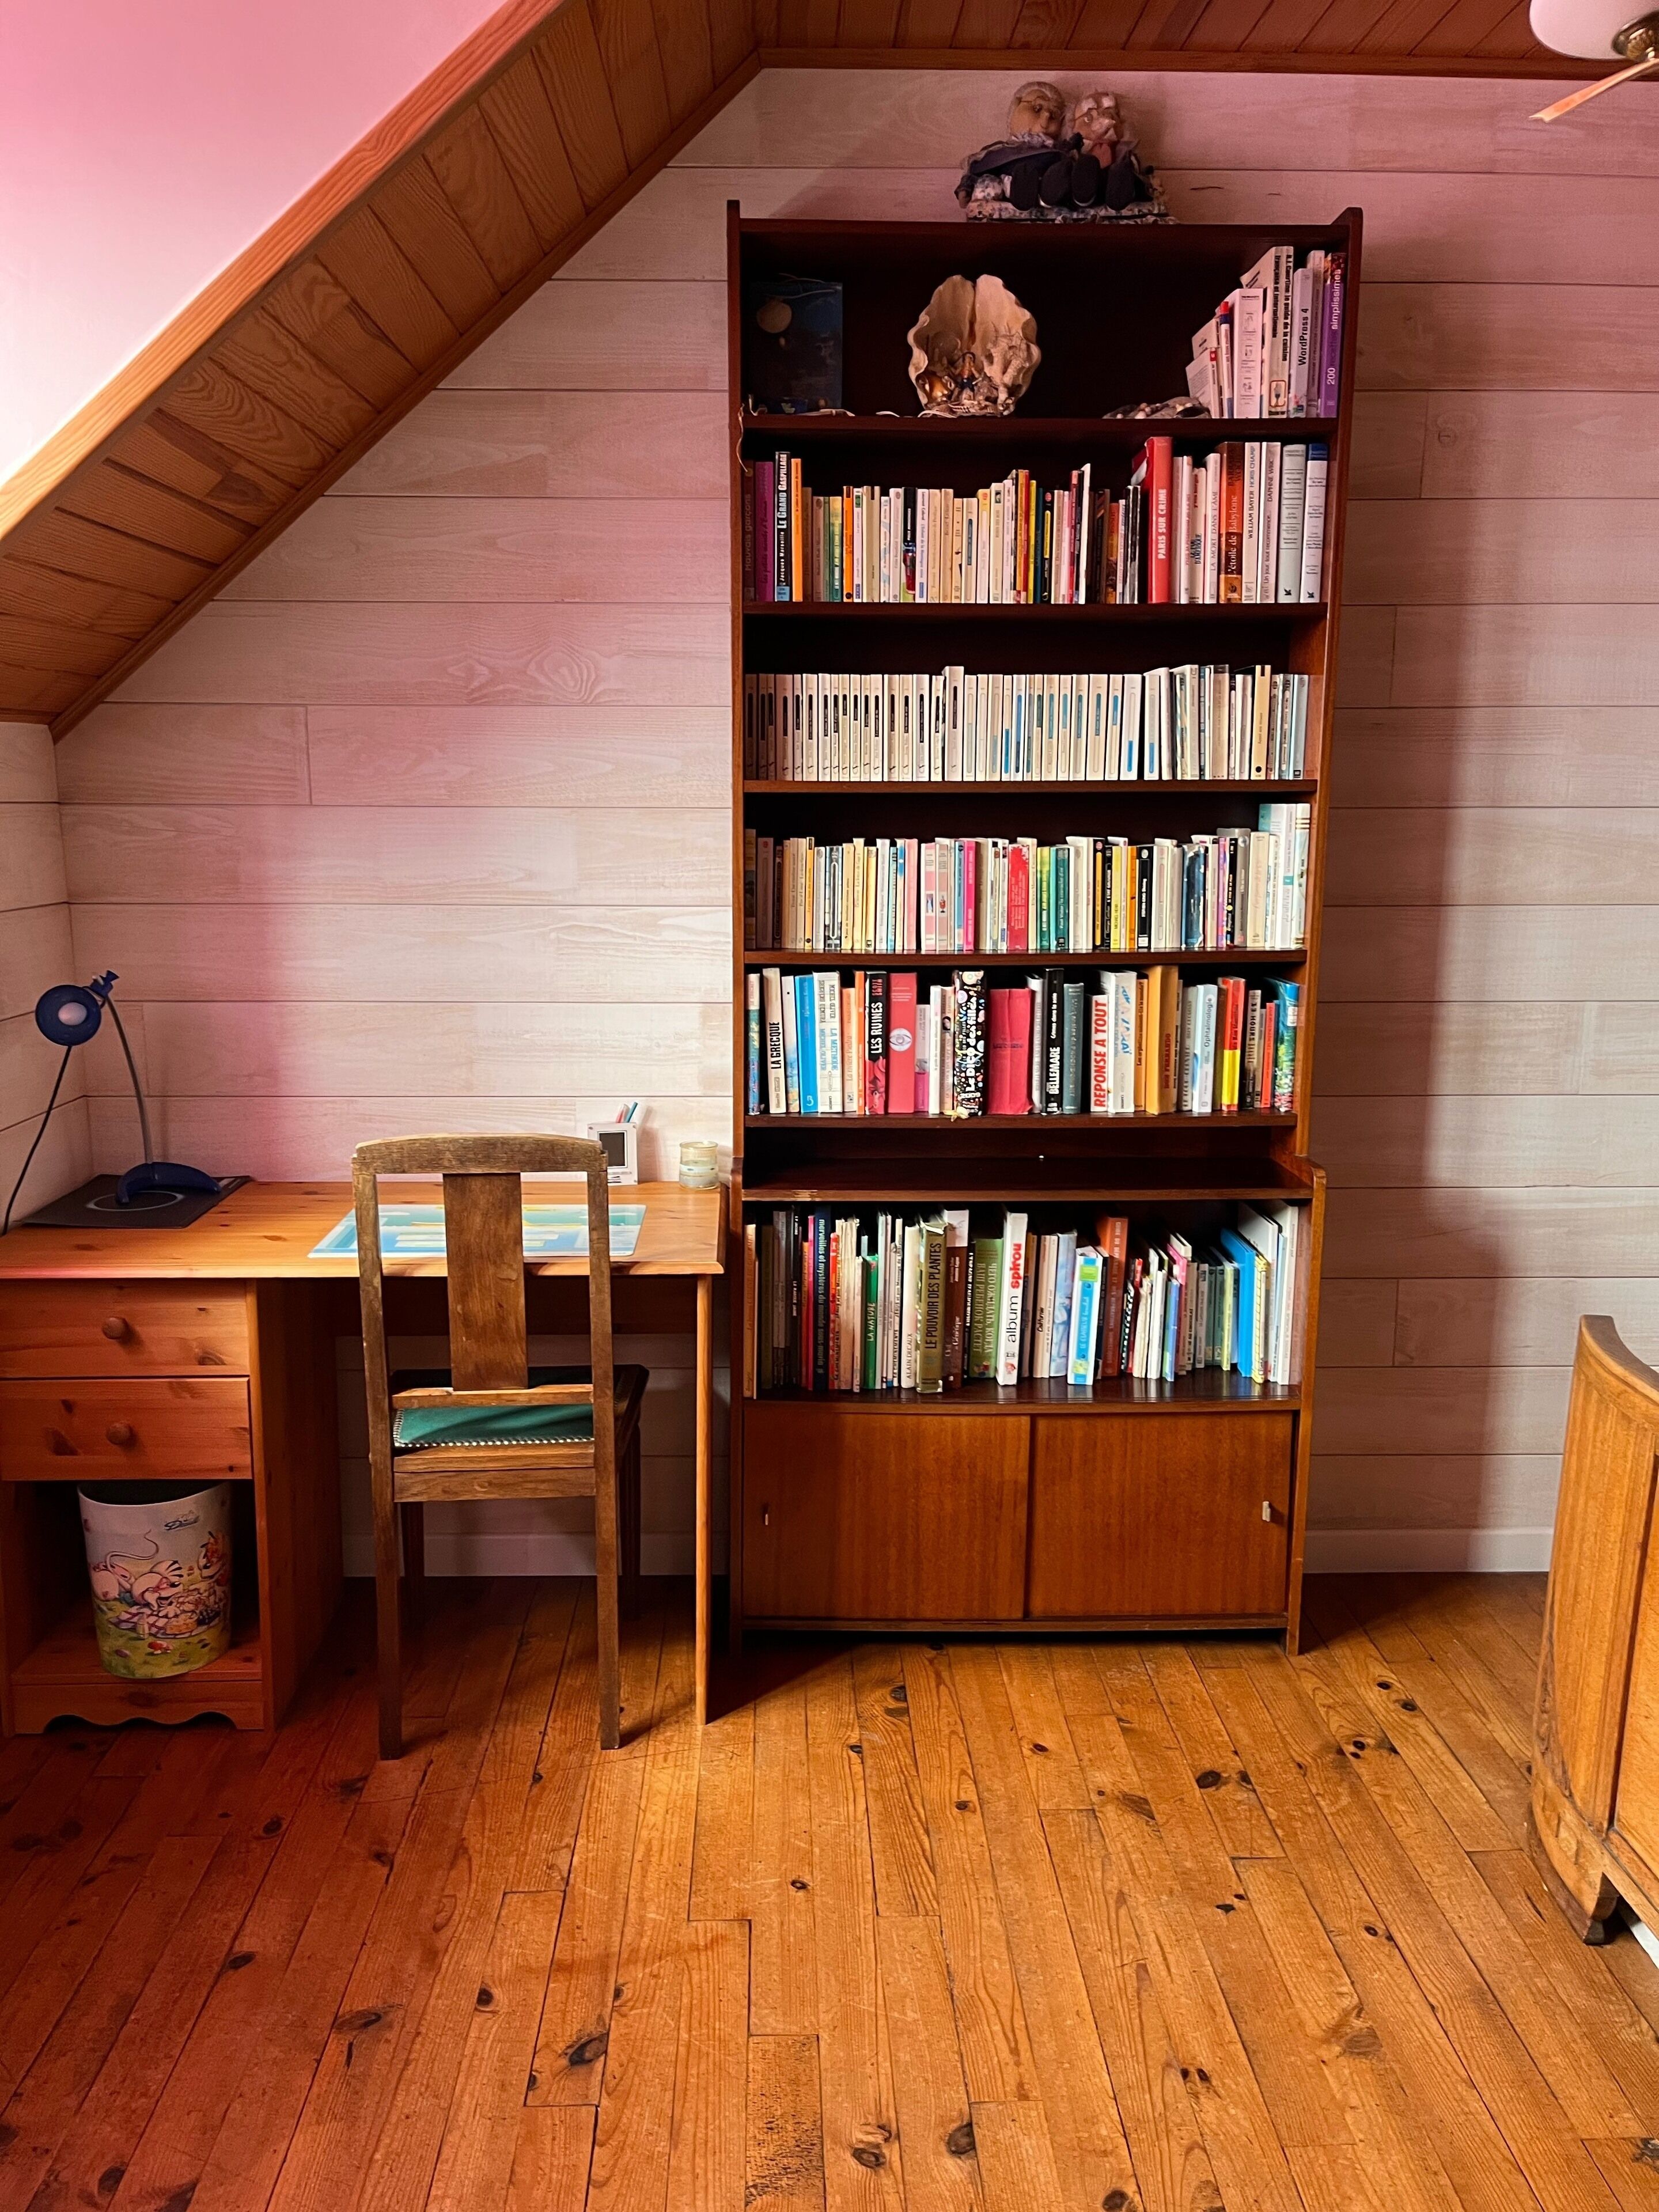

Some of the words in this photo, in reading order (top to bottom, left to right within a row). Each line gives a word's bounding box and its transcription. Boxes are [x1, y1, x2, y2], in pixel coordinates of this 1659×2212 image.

[1330, 269, 1341, 330] simplissimes
[1298, 316, 1309, 366] WordPress
[1327, 368, 1336, 384] 200
[778, 454, 787, 491] GASPILLAGE
[744, 494, 752, 531] garçons
[777, 492, 787, 518] GRAND
[1158, 488, 1166, 514] CRIME
[1228, 495, 1238, 532] Babylone
[777, 520, 787, 529] LE
[1158, 517, 1166, 532] SUR
[1158, 535, 1166, 559] PARIS
[1228, 536, 1236, 545] de
[1211, 562, 1216, 571] LA
[1228, 547, 1237, 575] L'étoile
[1264, 575, 1269, 584] Un
[871, 1002, 882, 1035] RUINES
[967, 996, 977, 1025] filles
[1094, 1001, 1107, 1035] TOUT
[1251, 1003, 1257, 1012] 13
[831, 1028, 837, 1037] LA
[967, 1025, 976, 1046] des
[1204, 998, 1213, 1047] Ophtalmologie
[768, 1022, 781, 1058] GRECQUE
[870, 1037, 882, 1054] LES
[1094, 1040, 1107, 1048] A
[771, 1060, 782, 1070] LA
[965, 1047, 976, 1076] DICO
[1048, 1047, 1060, 1094] BELLEMARE
[965, 1077, 975, 1092] Le
[1094, 1052, 1107, 1108] REPONSE
[817, 1219, 827, 1253] merveilles
[929, 1243, 941, 1280] PLANTES
[976, 1263, 986, 1282] ВАШ
[987, 1263, 997, 1283] ЧЕГО
[1009, 1243, 1022, 1289] spirou
[817, 1263, 827, 1293] mystères
[927, 1282, 940, 1298] DES
[818, 1295, 826, 1303] du
[975, 1285, 985, 1321] РЕБЕНОК
[985, 1285, 997, 1326] ОЖИДАТЬ,
[867, 1303, 875, 1330] NATURE
[925, 1301, 940, 1338] POUVOIR
[1006, 1296, 1018, 1343] album
[866, 1332, 874, 1341] LA
[925, 1339, 937, 1349] LE
[973, 1324, 983, 1353] РАСТЕТ
[984, 1328, 994, 1353] КОГДА
